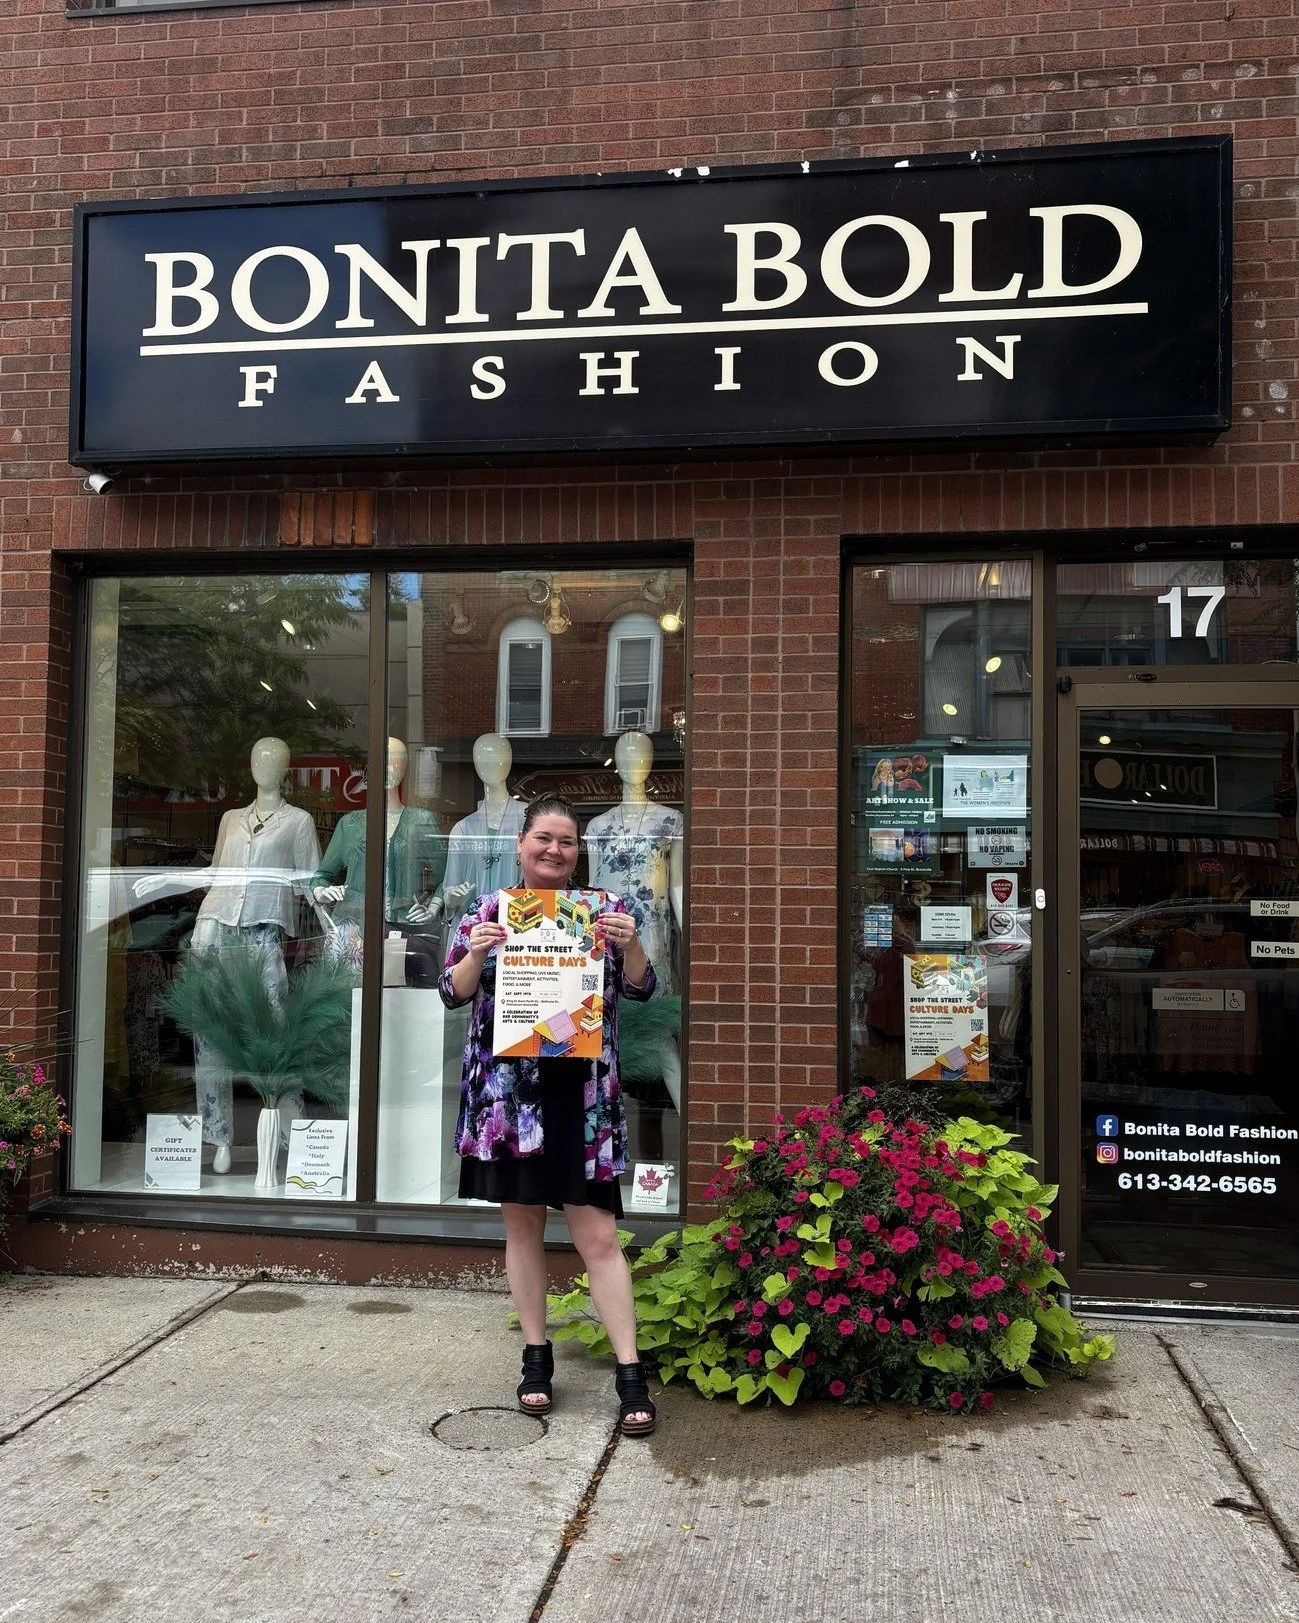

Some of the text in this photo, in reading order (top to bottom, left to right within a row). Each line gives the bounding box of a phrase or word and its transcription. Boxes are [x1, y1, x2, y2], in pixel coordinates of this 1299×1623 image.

[143, 205, 1143, 337] BONITA BOLD
[238, 335, 1022, 408] FASHION
[1157, 586, 1226, 638] 17
[975, 827, 1018, 836] NO SMOKING
[979, 845, 1015, 853] NO VAPING
[504, 945, 573, 953] SHOP THE STREET
[1256, 945, 1295, 955] No Pets
[503, 955, 587, 968] CULTURE DAYS
[909, 1005, 974, 1014] CULTURE DAYS
[1124, 1122, 1298, 1140] Bonita Bold Fashion
[1123, 1147, 1281, 1165] bonitaboldfashion
[1118, 1172, 1277, 1195] 613-342-6565
